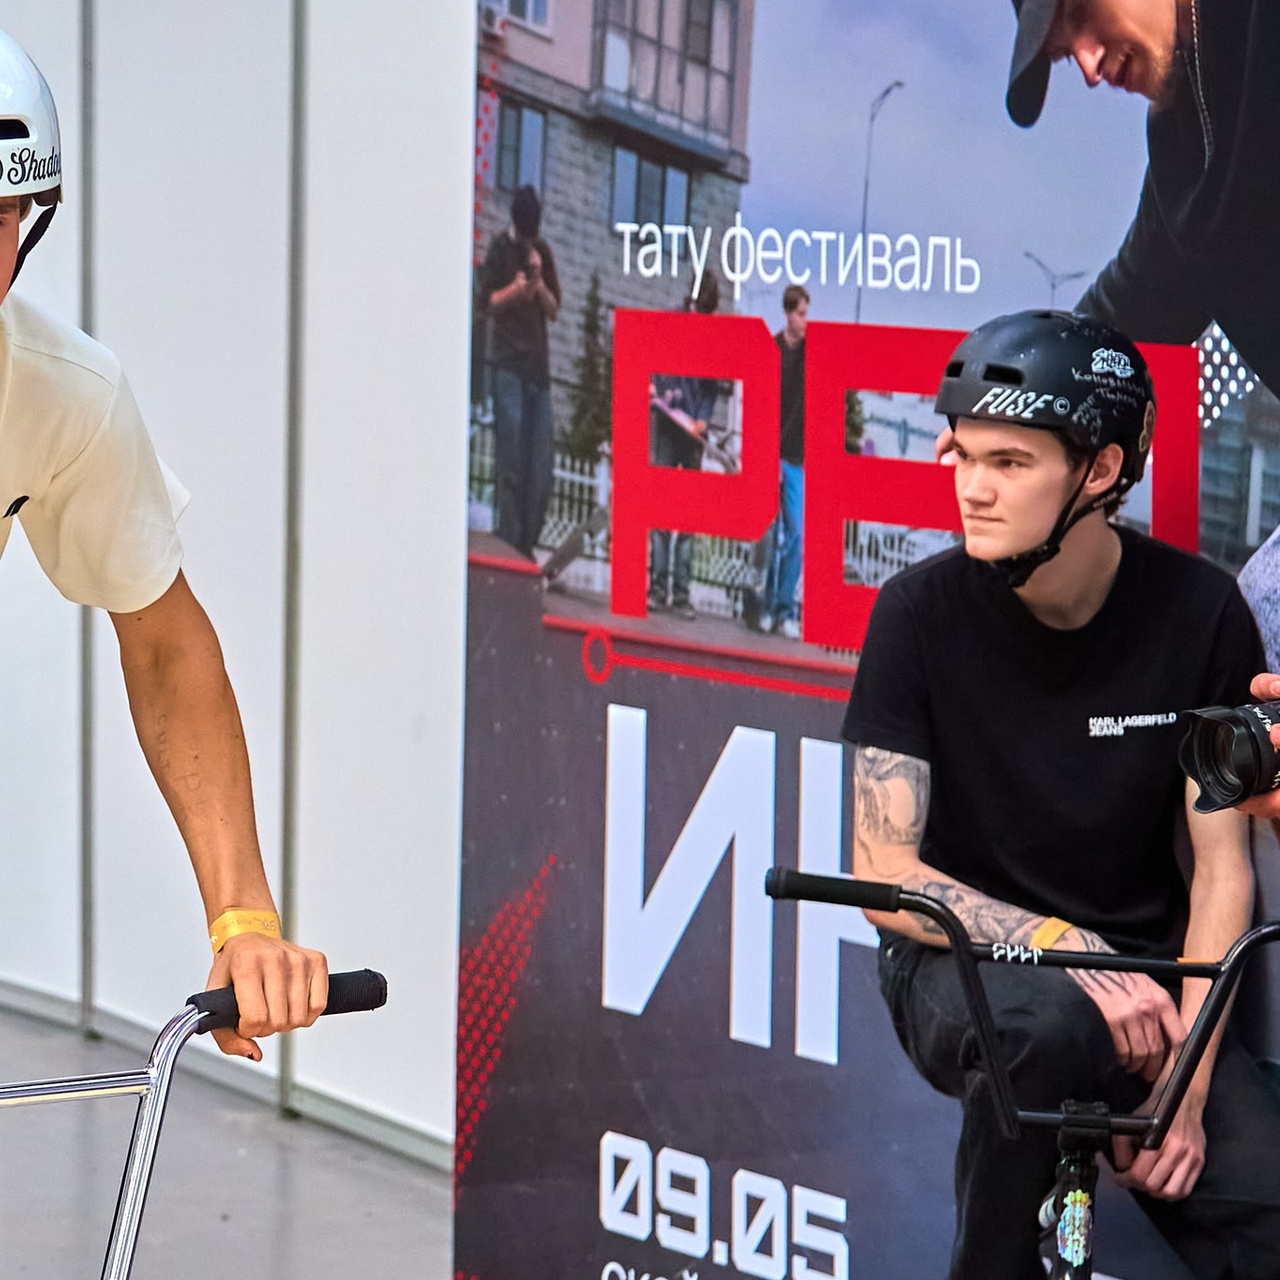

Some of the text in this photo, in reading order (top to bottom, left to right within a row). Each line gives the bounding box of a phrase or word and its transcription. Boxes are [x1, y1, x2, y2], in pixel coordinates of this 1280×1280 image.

[7, 146, 61, 186] Shado
[614, 211, 981, 302] тату фестиваль
[971, 386, 1054, 419] FUSE
[1088, 712, 1177, 729] KARL LAGERFELD
[1088, 725, 1125, 737] JEANS
